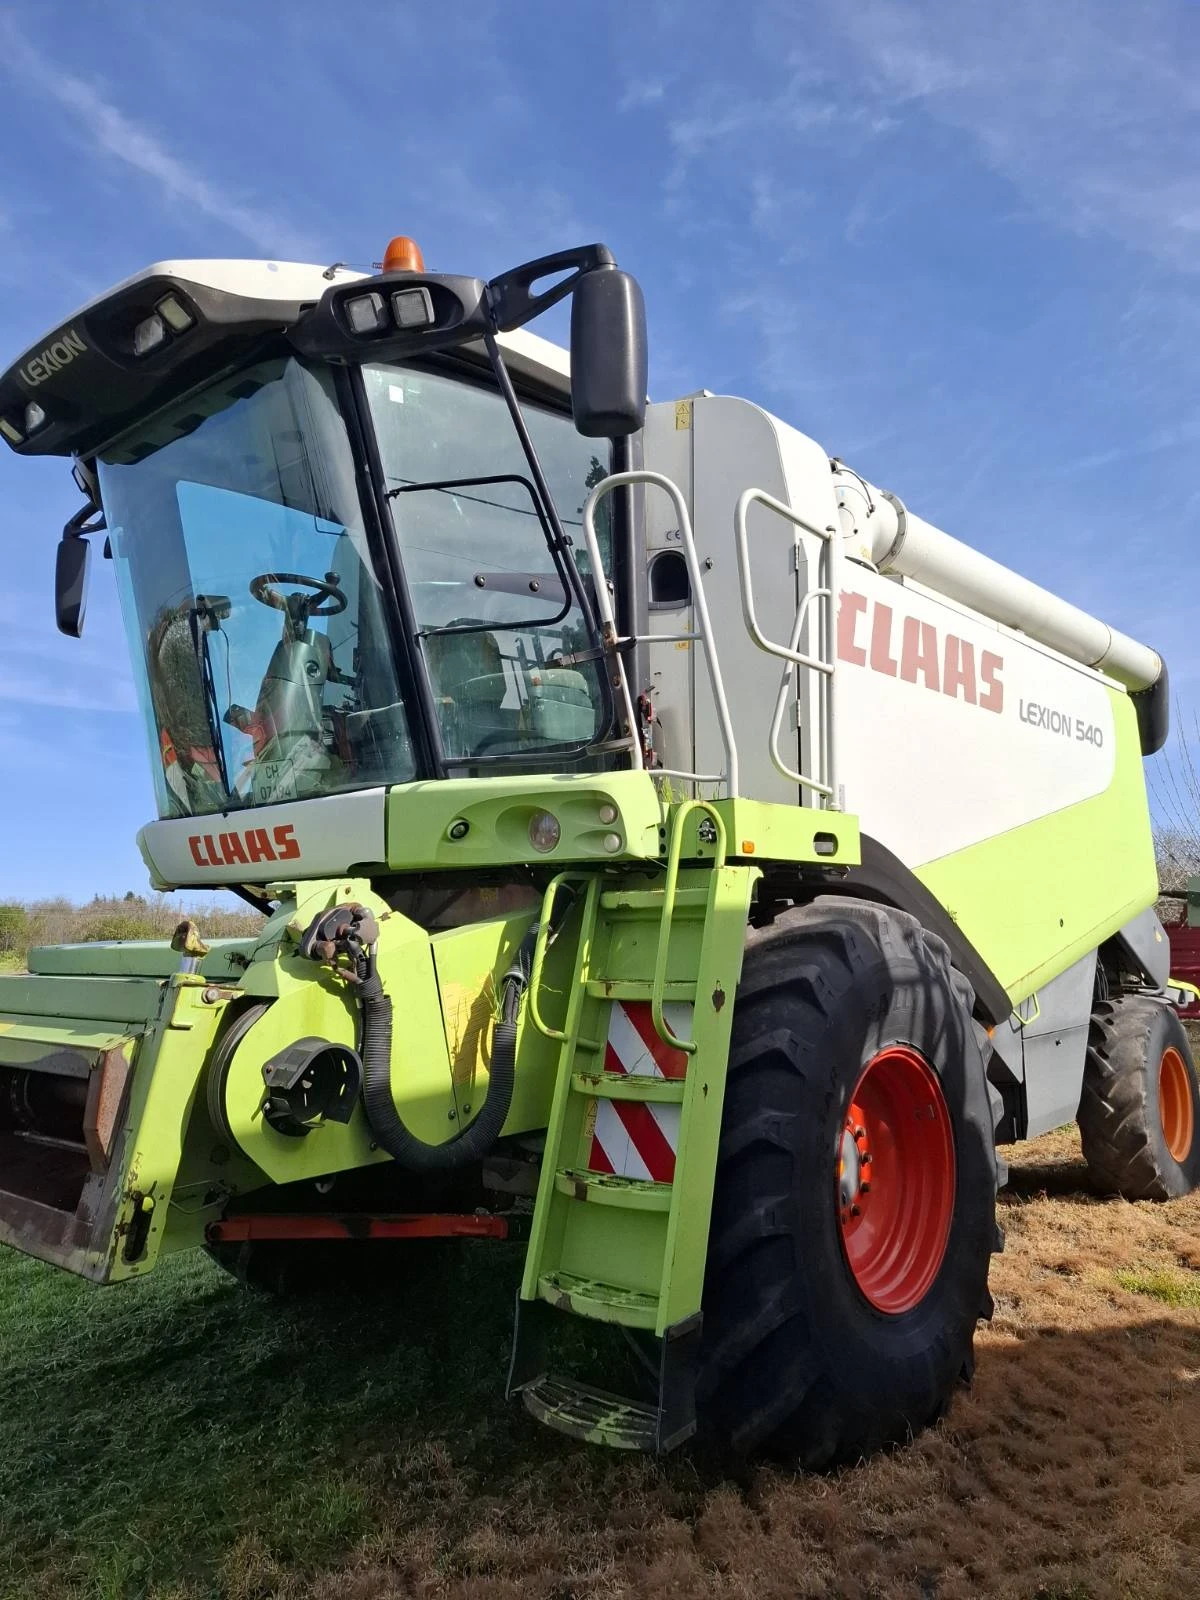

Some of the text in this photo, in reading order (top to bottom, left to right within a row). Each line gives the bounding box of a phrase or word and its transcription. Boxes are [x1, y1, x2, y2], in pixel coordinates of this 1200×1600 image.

[19, 329, 88, 386] LEXION
[837, 589, 1004, 715] CLAAS
[1019, 698, 1104, 749] LEXION 540
[188, 824, 301, 867] CLAAS
